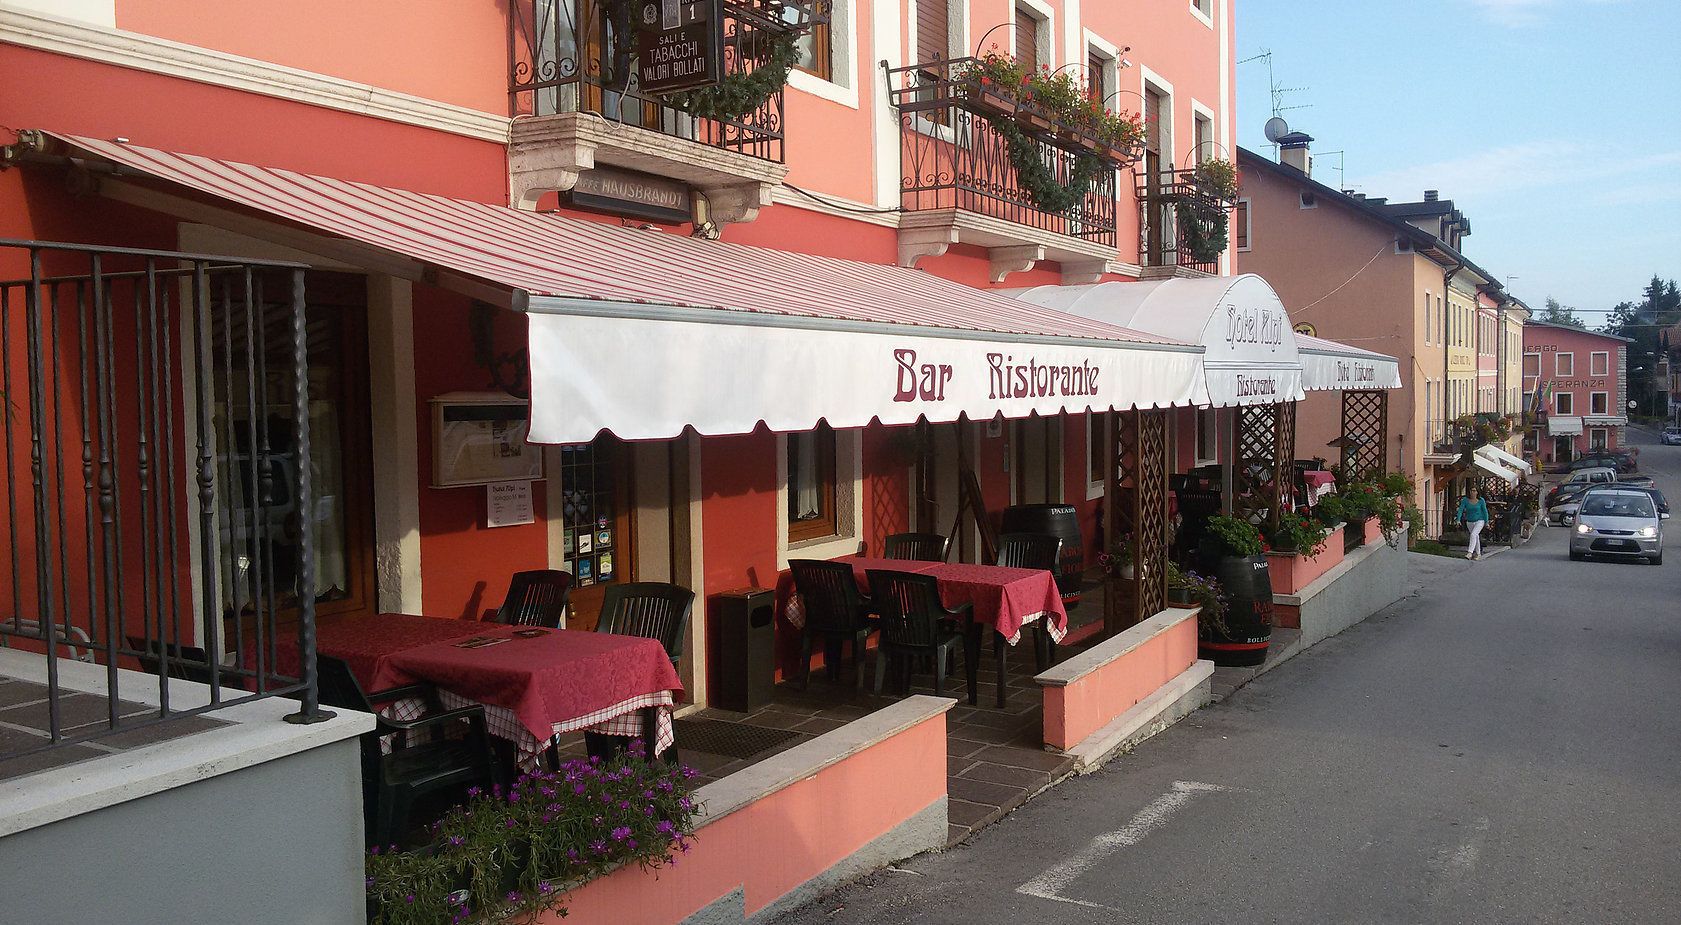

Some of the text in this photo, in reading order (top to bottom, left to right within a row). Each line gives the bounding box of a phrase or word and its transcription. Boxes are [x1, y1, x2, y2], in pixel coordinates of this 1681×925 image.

[659, 31, 687, 45] SALI E
[649, 41, 698, 64] TABACCHI
[643, 57, 705, 82] VALORI BOLLATI
[893, 348, 1099, 402] Bar Ristorante
[1236, 374, 1276, 397] Ristorante
[1543, 380, 1605, 388] SPERANZA
